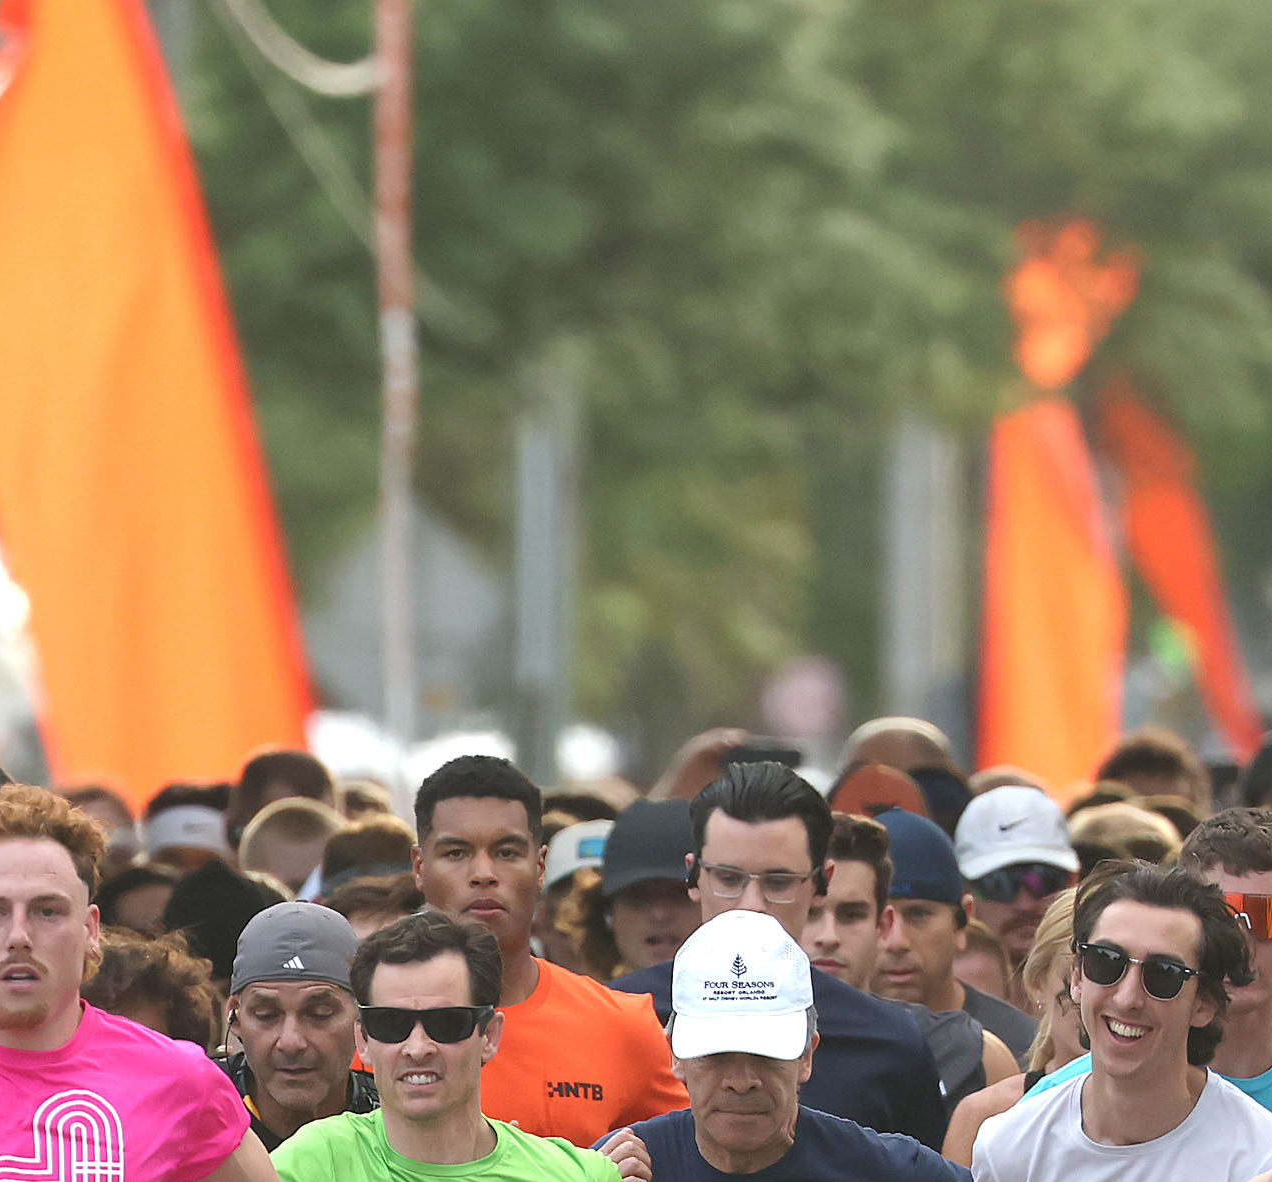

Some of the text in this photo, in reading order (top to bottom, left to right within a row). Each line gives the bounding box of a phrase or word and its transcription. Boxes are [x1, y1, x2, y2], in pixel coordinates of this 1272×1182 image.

[704, 980, 775, 989] FOUR SEASONS
[548, 1082, 603, 1101] HNTB
